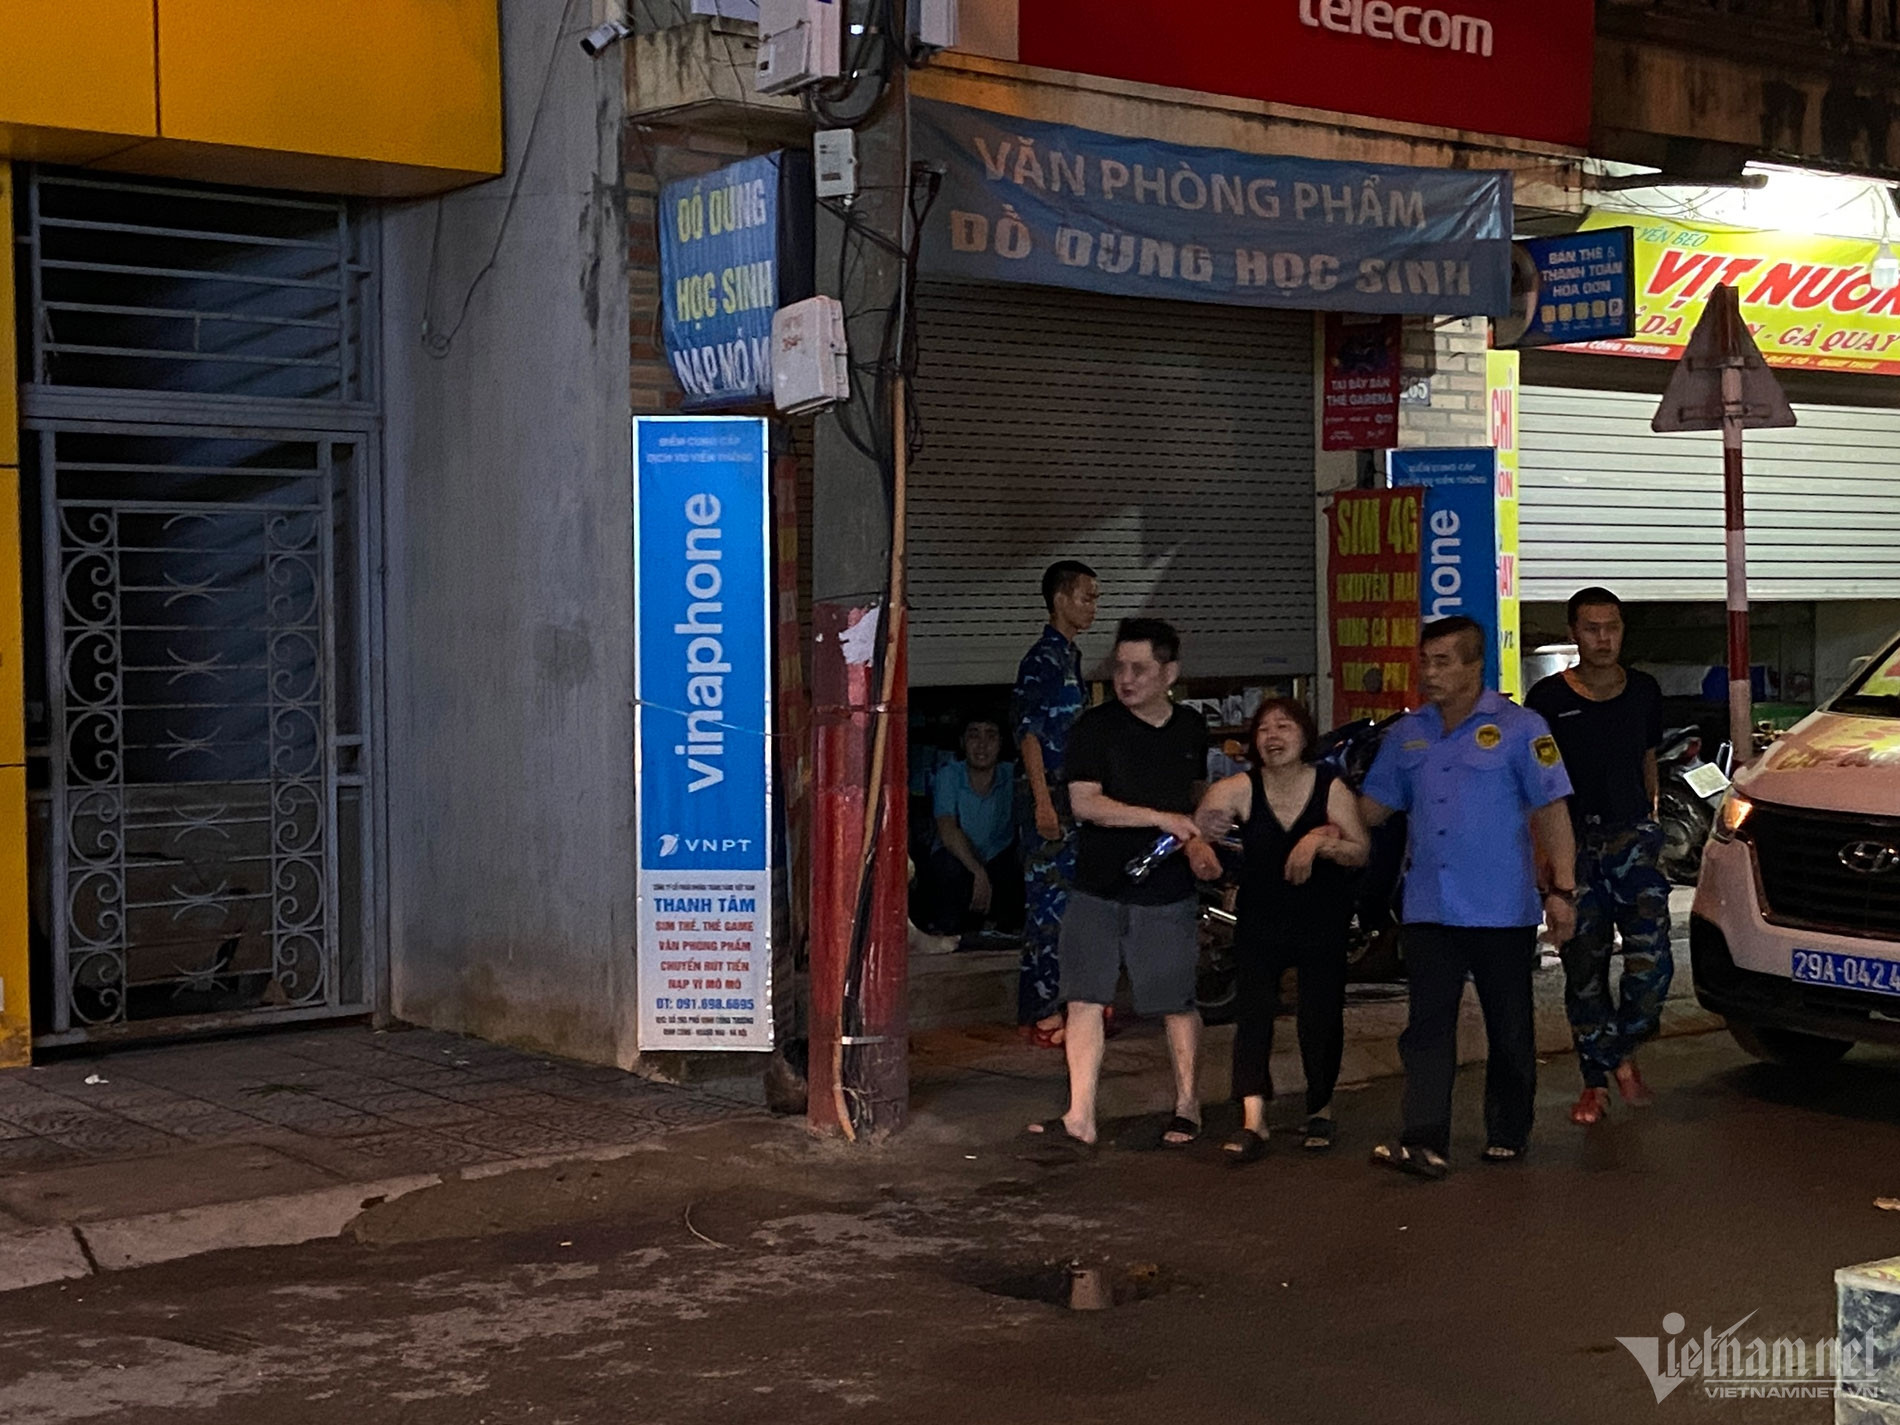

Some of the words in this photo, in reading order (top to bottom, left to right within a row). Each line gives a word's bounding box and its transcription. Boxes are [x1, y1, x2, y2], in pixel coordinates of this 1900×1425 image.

[1299, 0, 1493, 57] telecom
[974, 136, 1085, 196] VĂN
[1101, 159, 1280, 218] PHÒNG
[1294, 174, 1427, 231] PHẨM
[676, 272, 717, 331] HỌC
[722, 260, 773, 314] SINH
[1235, 249, 1339, 297] HỌC
[1356, 258, 1471, 297] SINH
[1647, 250, 1764, 309] VỊT
[1819, 331, 1900, 352] QUAY
[1337, 498, 1380, 556] SIM
[1387, 496, 1418, 553] 4G
[1422, 508, 1463, 624] hone
[674, 493, 732, 792] vinaphone
[685, 839, 752, 852] VNPT
[654, 897, 712, 913] THANH
[718, 894, 756, 913] TÂM
[655, 920, 676, 932] SIM
[724, 920, 755, 932] GAME
